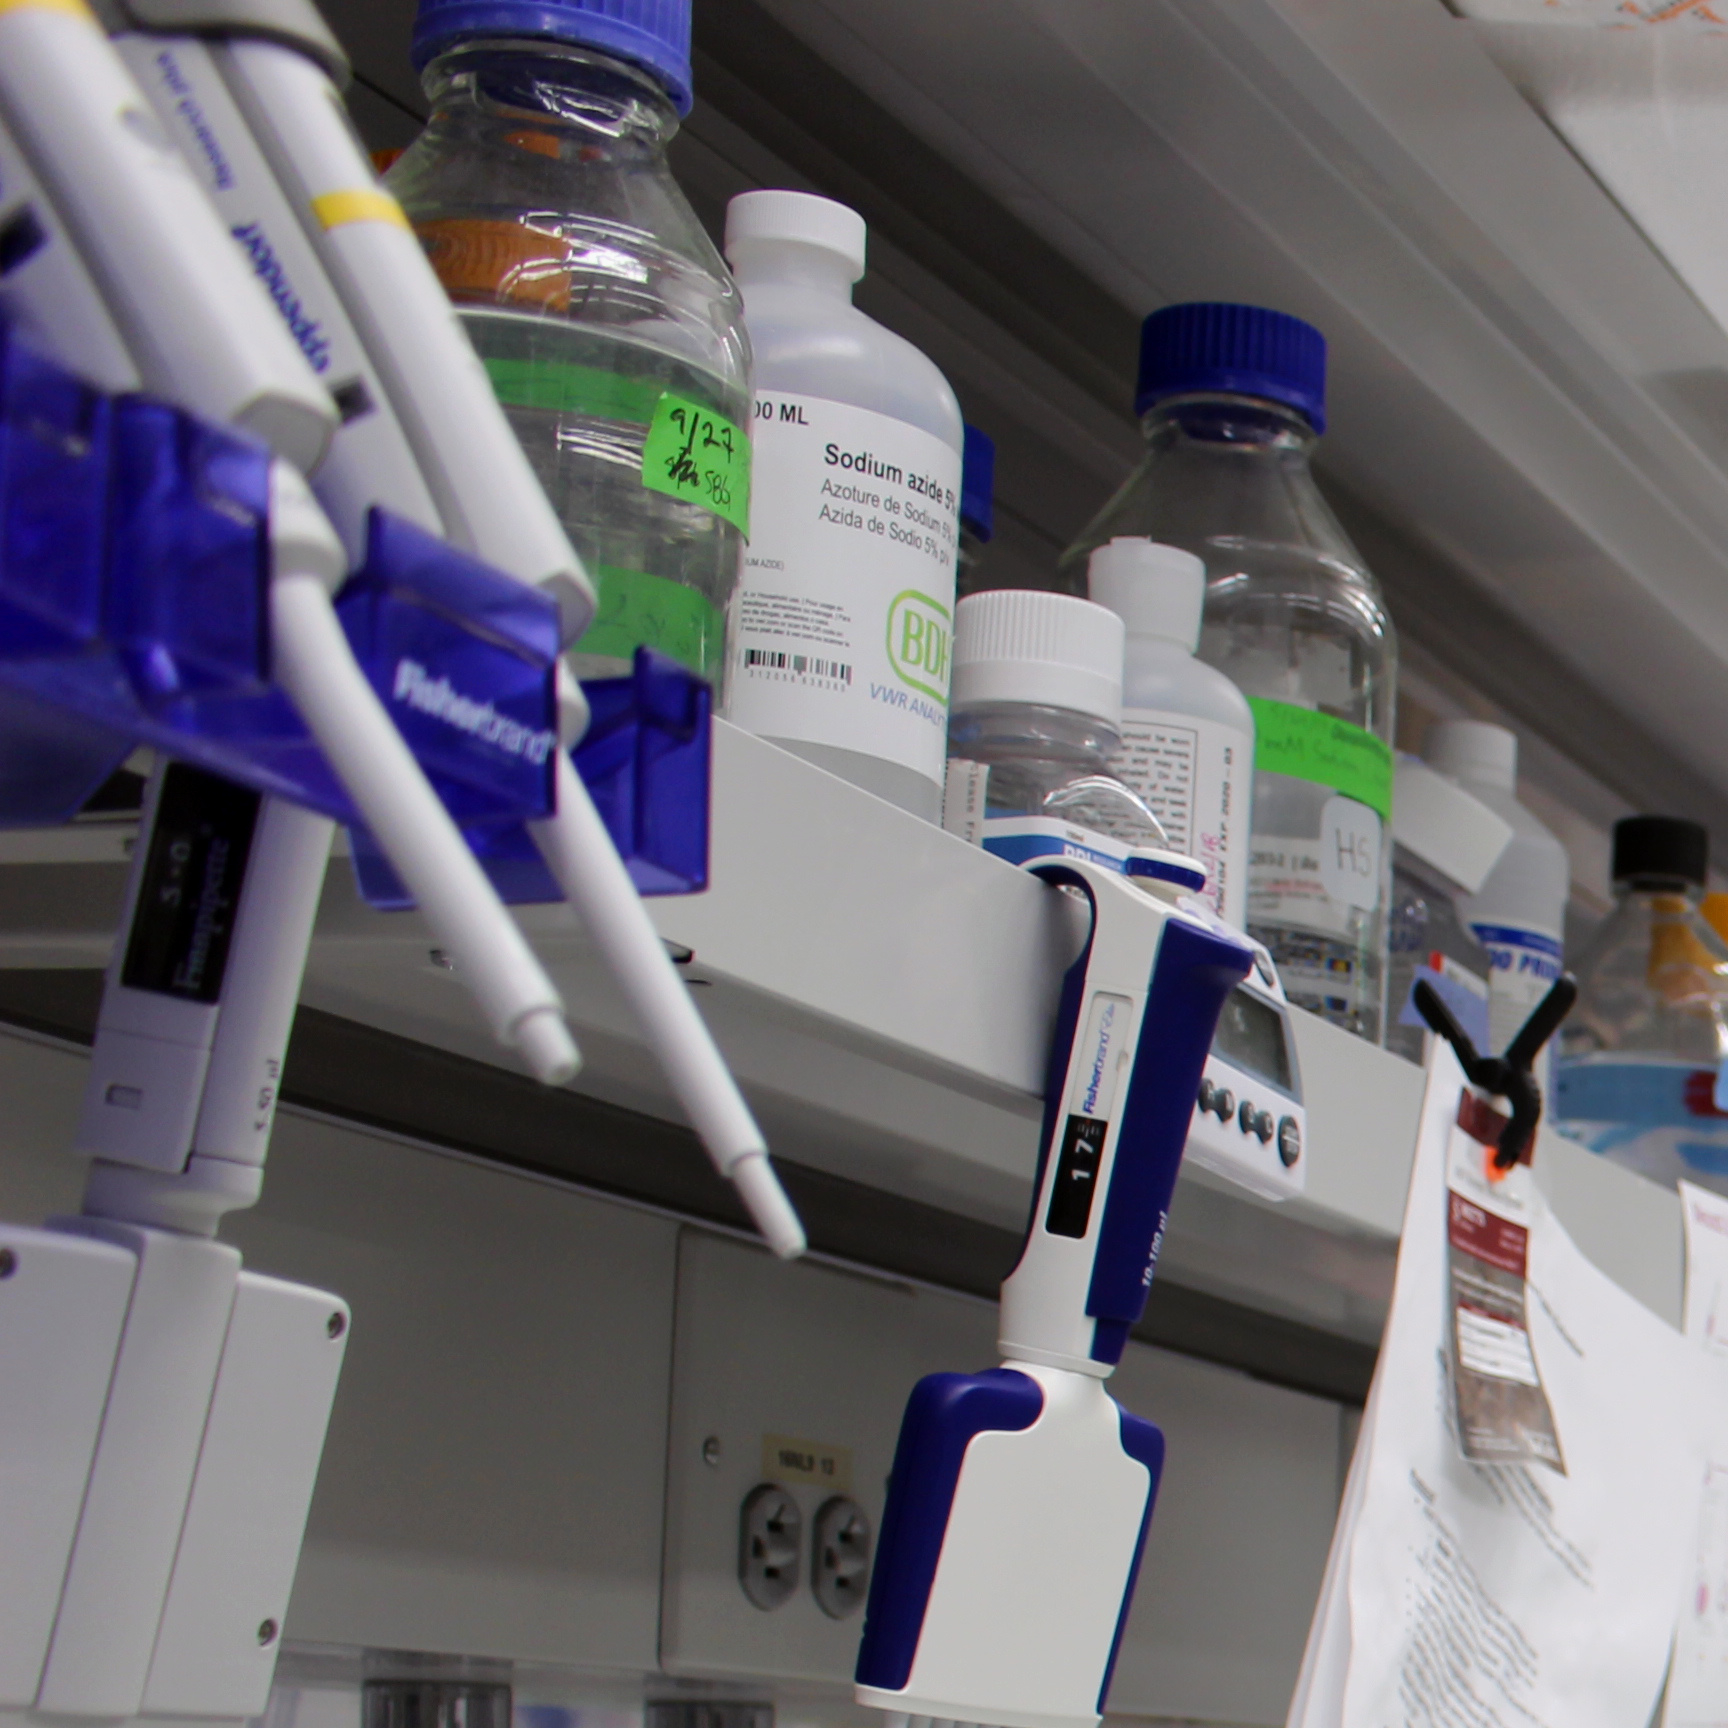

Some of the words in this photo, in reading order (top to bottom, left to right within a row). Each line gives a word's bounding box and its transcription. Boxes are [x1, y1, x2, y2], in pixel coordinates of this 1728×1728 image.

[231, 218, 332, 376] eppendorf
[779, 404, 809, 425] ML
[824, 443, 902, 485] Sodium
[907, 472, 943, 504] azide
[819, 503, 863, 530] Azida
[867, 516, 885, 535] de
[889, 521, 922, 548] Sodio
[820, 477, 880, 508] Azoture
[884, 496, 901, 515] de
[904, 501, 941, 532] Sodium
[760, 558, 785, 571] AZIDE)
[395, 659, 555, 764] Fisherbrand
[870, 682, 907, 710] VWR
[1219, 821, 1227, 852] EXP
[1082, 1026, 1111, 1115] Fisherbrand
[1141, 1230, 1165, 1288] 10-100
